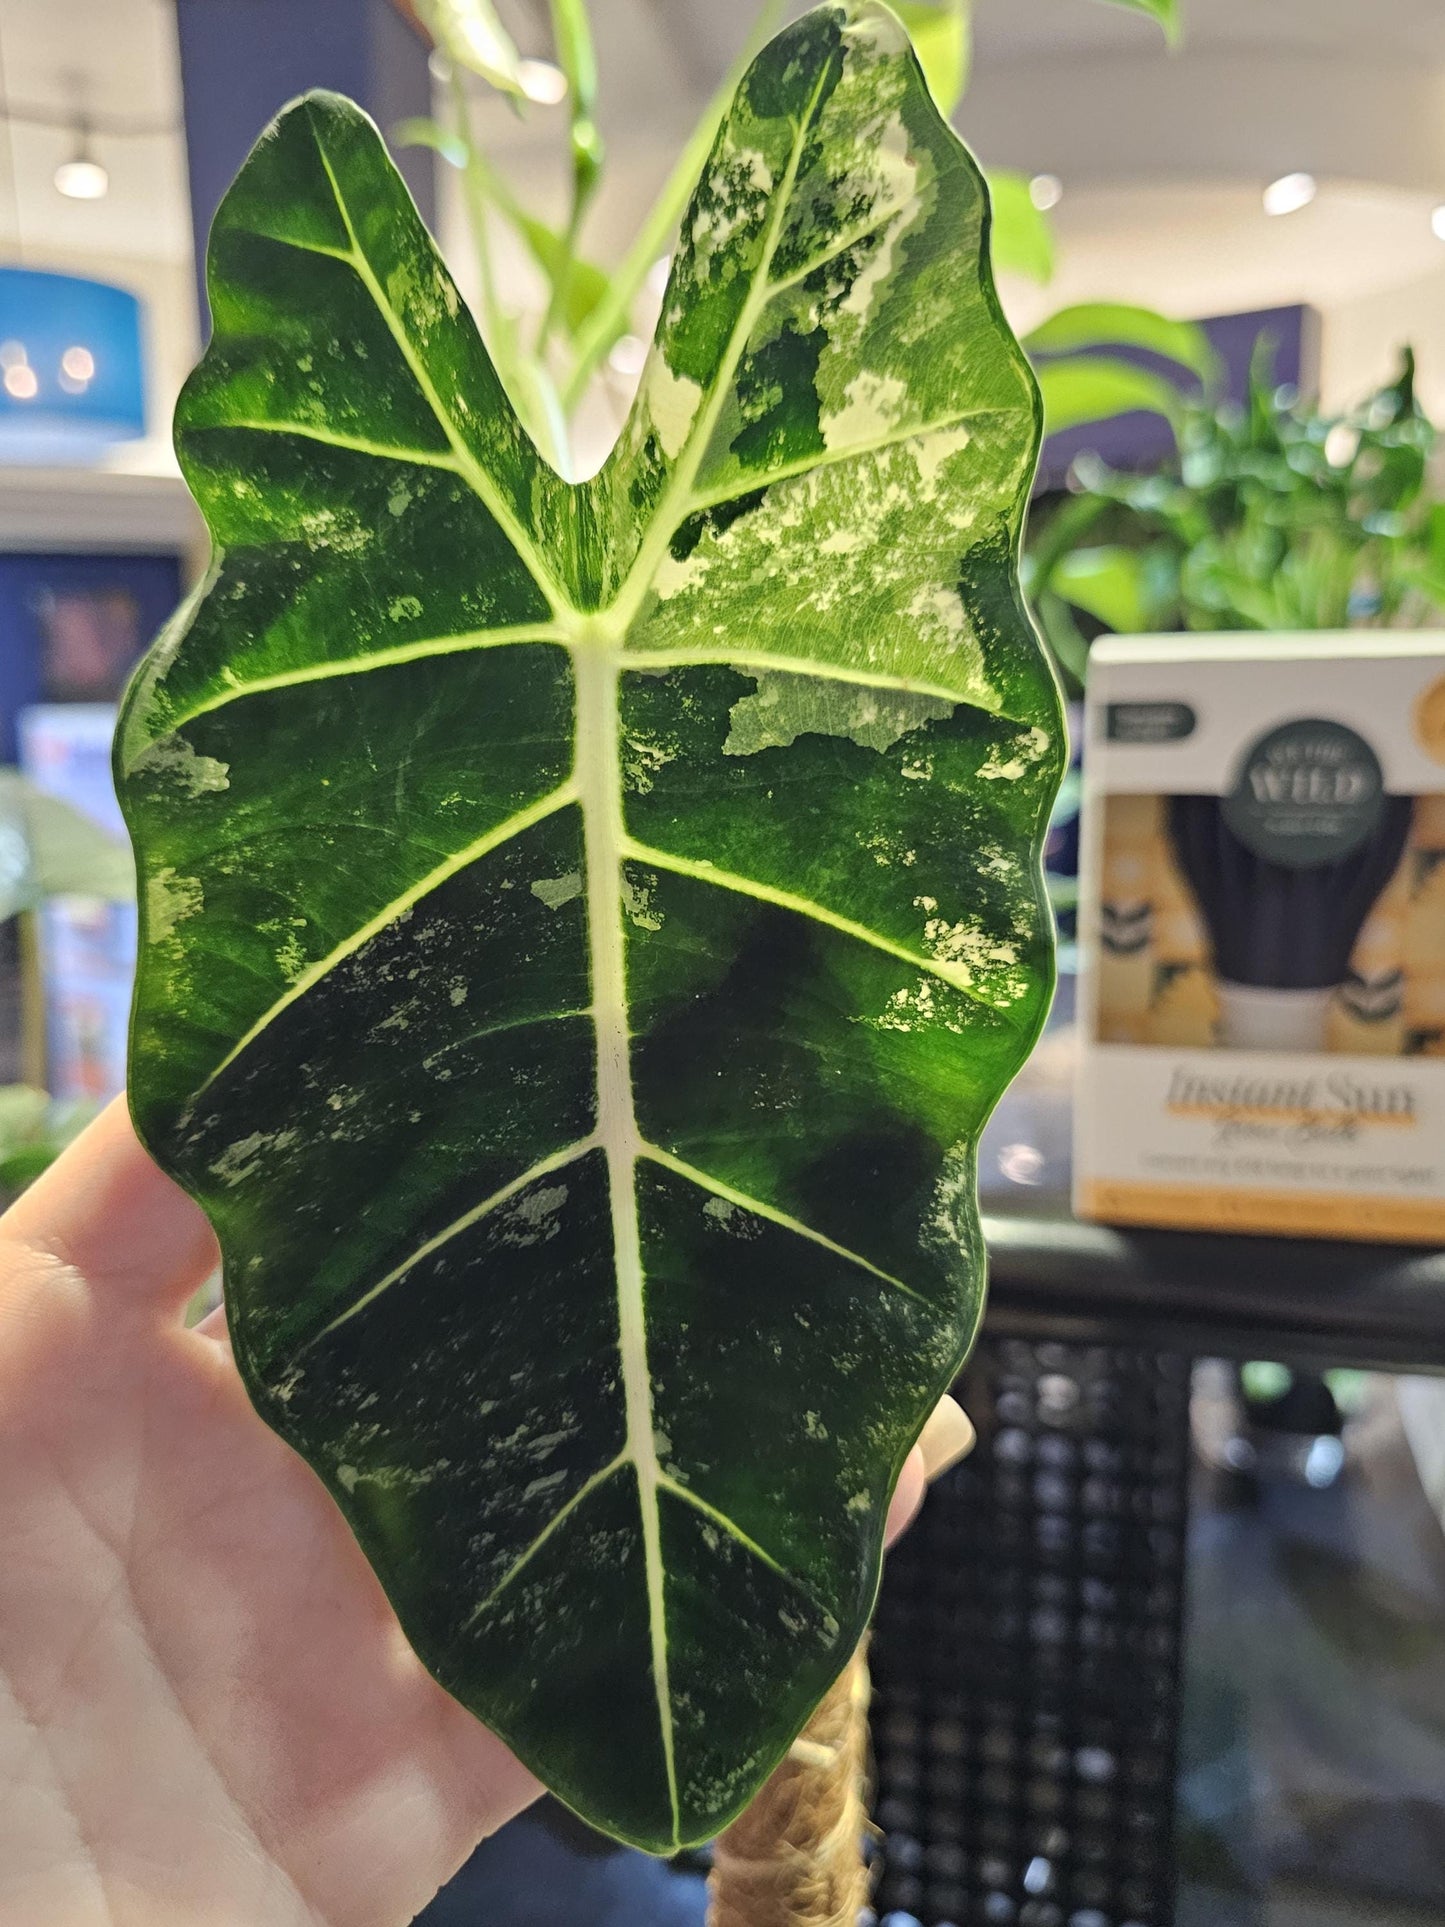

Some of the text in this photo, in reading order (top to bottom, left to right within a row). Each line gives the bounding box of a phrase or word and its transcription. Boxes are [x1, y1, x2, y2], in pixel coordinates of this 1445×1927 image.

[1249, 763, 1366, 805] WILD
[1166, 1063, 1416, 1114] Instant Sun
